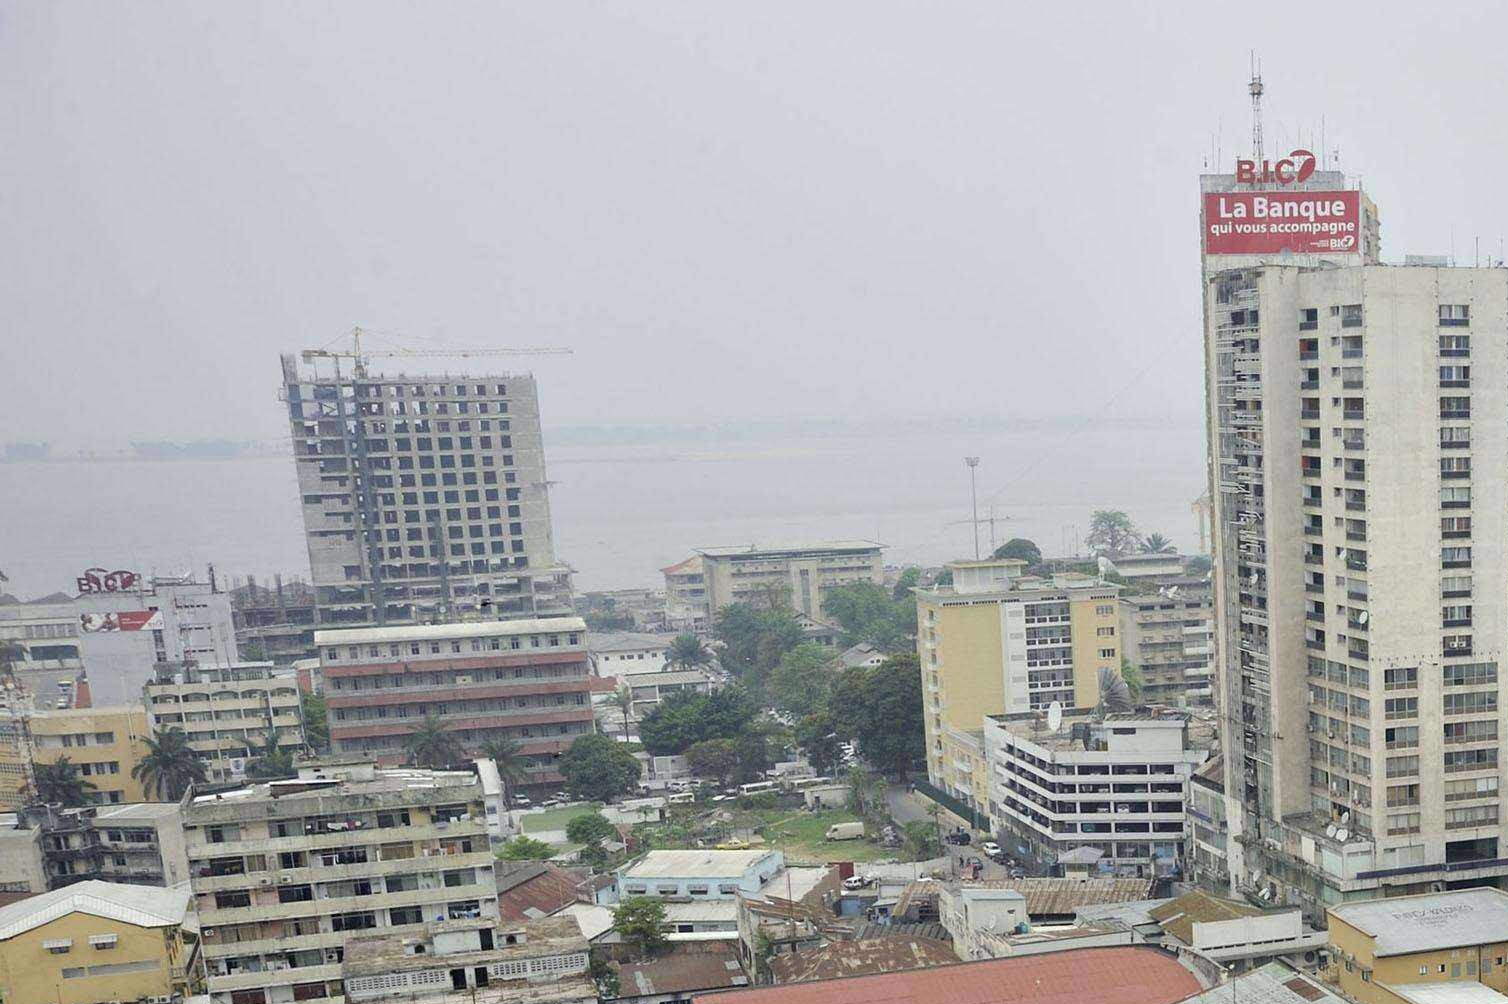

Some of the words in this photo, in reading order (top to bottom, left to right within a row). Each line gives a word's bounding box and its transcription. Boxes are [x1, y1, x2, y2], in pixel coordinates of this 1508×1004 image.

[1219, 197, 1247, 218] La
[1253, 197, 1346, 221] Banque
[1210, 222, 1232, 236] qui
[1234, 224, 1267, 234] vous
[1269, 221, 1355, 235] accompagne
